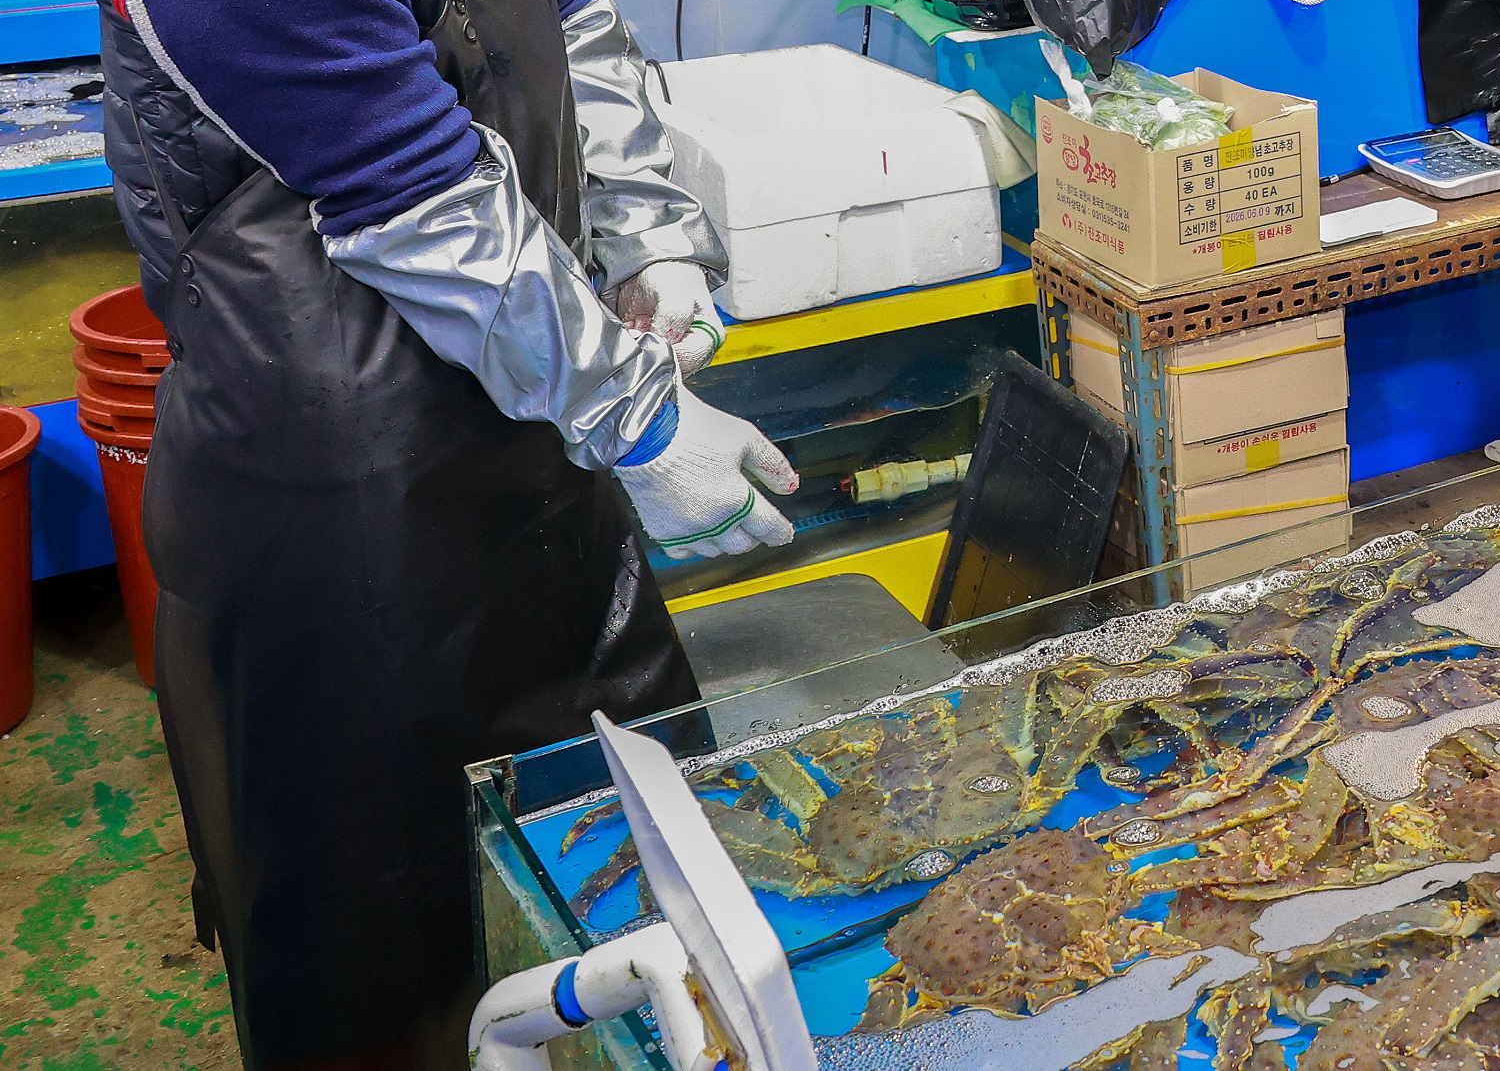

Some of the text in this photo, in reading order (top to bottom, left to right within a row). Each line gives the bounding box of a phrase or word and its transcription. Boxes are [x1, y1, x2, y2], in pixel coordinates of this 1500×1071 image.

[1264, 138, 1293, 156] 초고추장
[1247, 166, 1275, 180] 100g
[1245, 186, 1278, 202] 40 EA
[1274, 202, 1295, 217] 까지
[1074, 219, 1125, 255] (주)진조미식품
[1184, 220, 1217, 238] 소비기한
